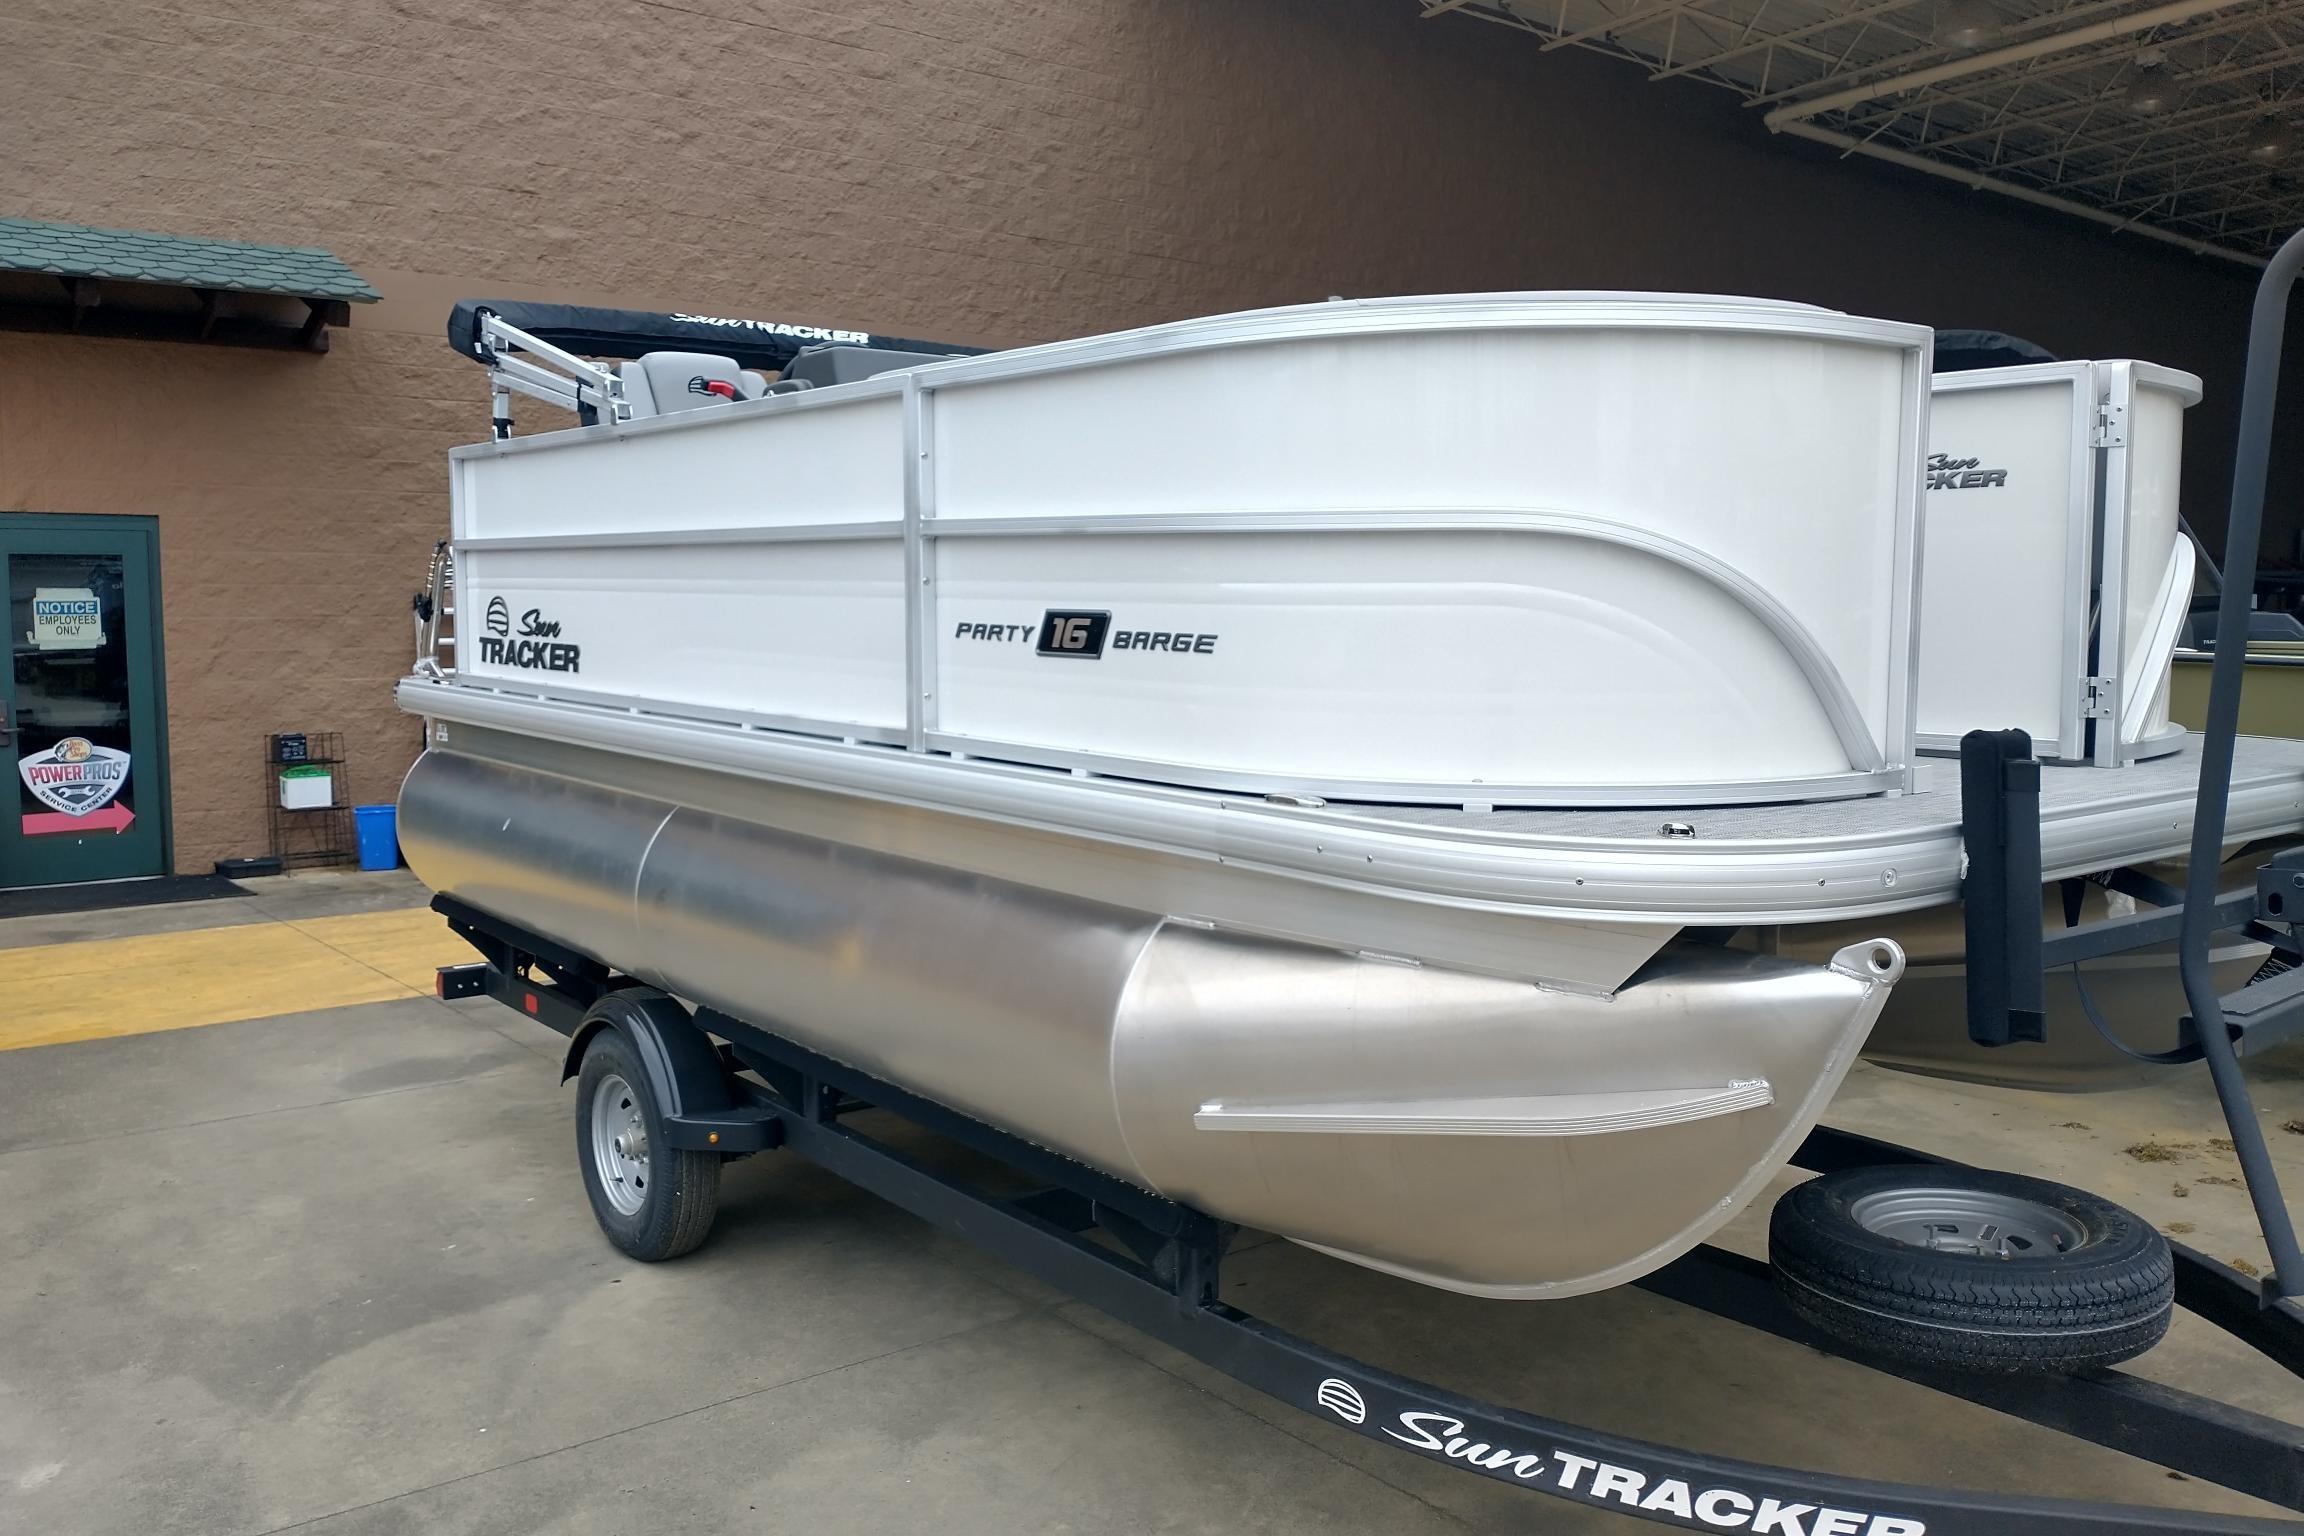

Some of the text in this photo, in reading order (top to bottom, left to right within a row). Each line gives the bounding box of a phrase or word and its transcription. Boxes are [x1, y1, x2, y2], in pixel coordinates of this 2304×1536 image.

[744, 319, 870, 344] TRACKER
[38, 602, 96, 614] NOTICE
[39, 614, 97, 625] EMPLOYEES
[55, 625, 81, 635] ONLY
[516, 608, 562, 639] Sun
[955, 617, 1218, 654] PARTY 16 BARGE
[479, 636, 580, 673] TRACKER
[40, 787, 113, 812] SERVICE CENTER
[1381, 1411, 1546, 1479] Sun
